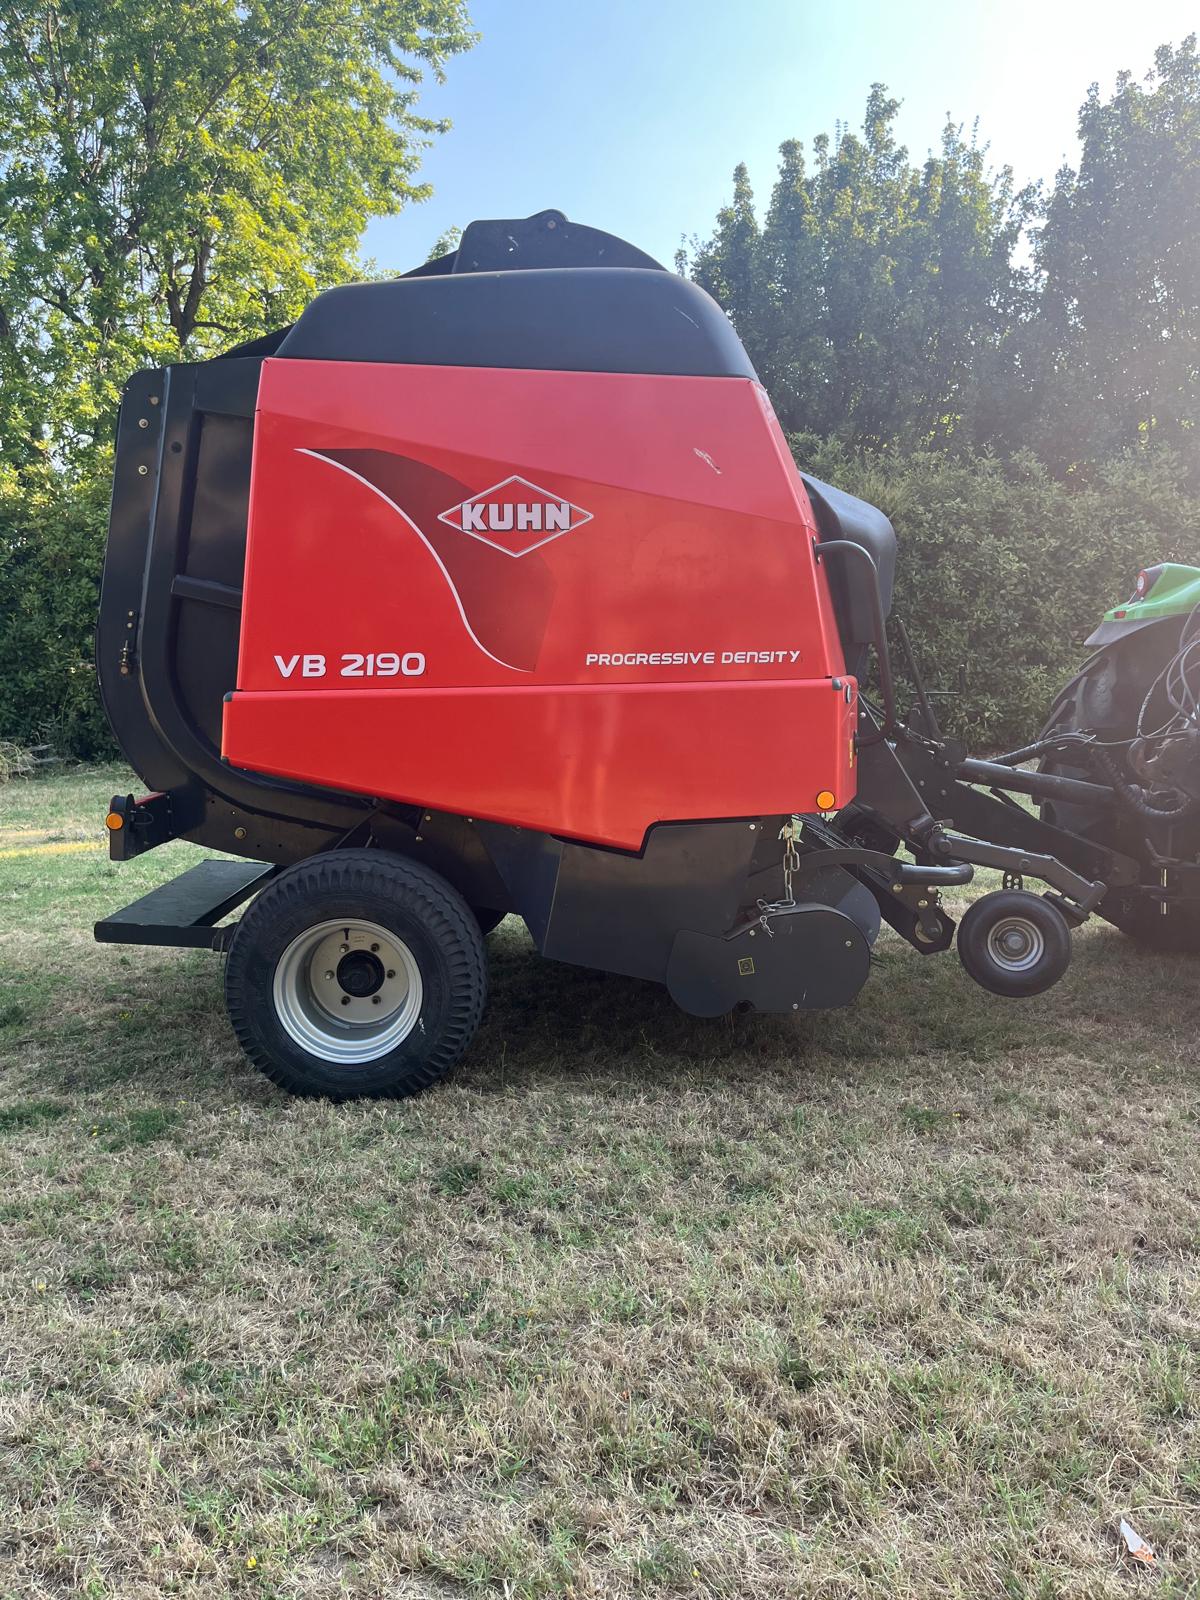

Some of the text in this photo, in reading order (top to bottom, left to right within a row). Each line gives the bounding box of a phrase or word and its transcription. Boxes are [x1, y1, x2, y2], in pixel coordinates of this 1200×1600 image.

[461, 503, 572, 531] KUHN
[273, 652, 426, 678] VB 2190
[586, 650, 801, 666] PROGRESSIVE DENSITY
